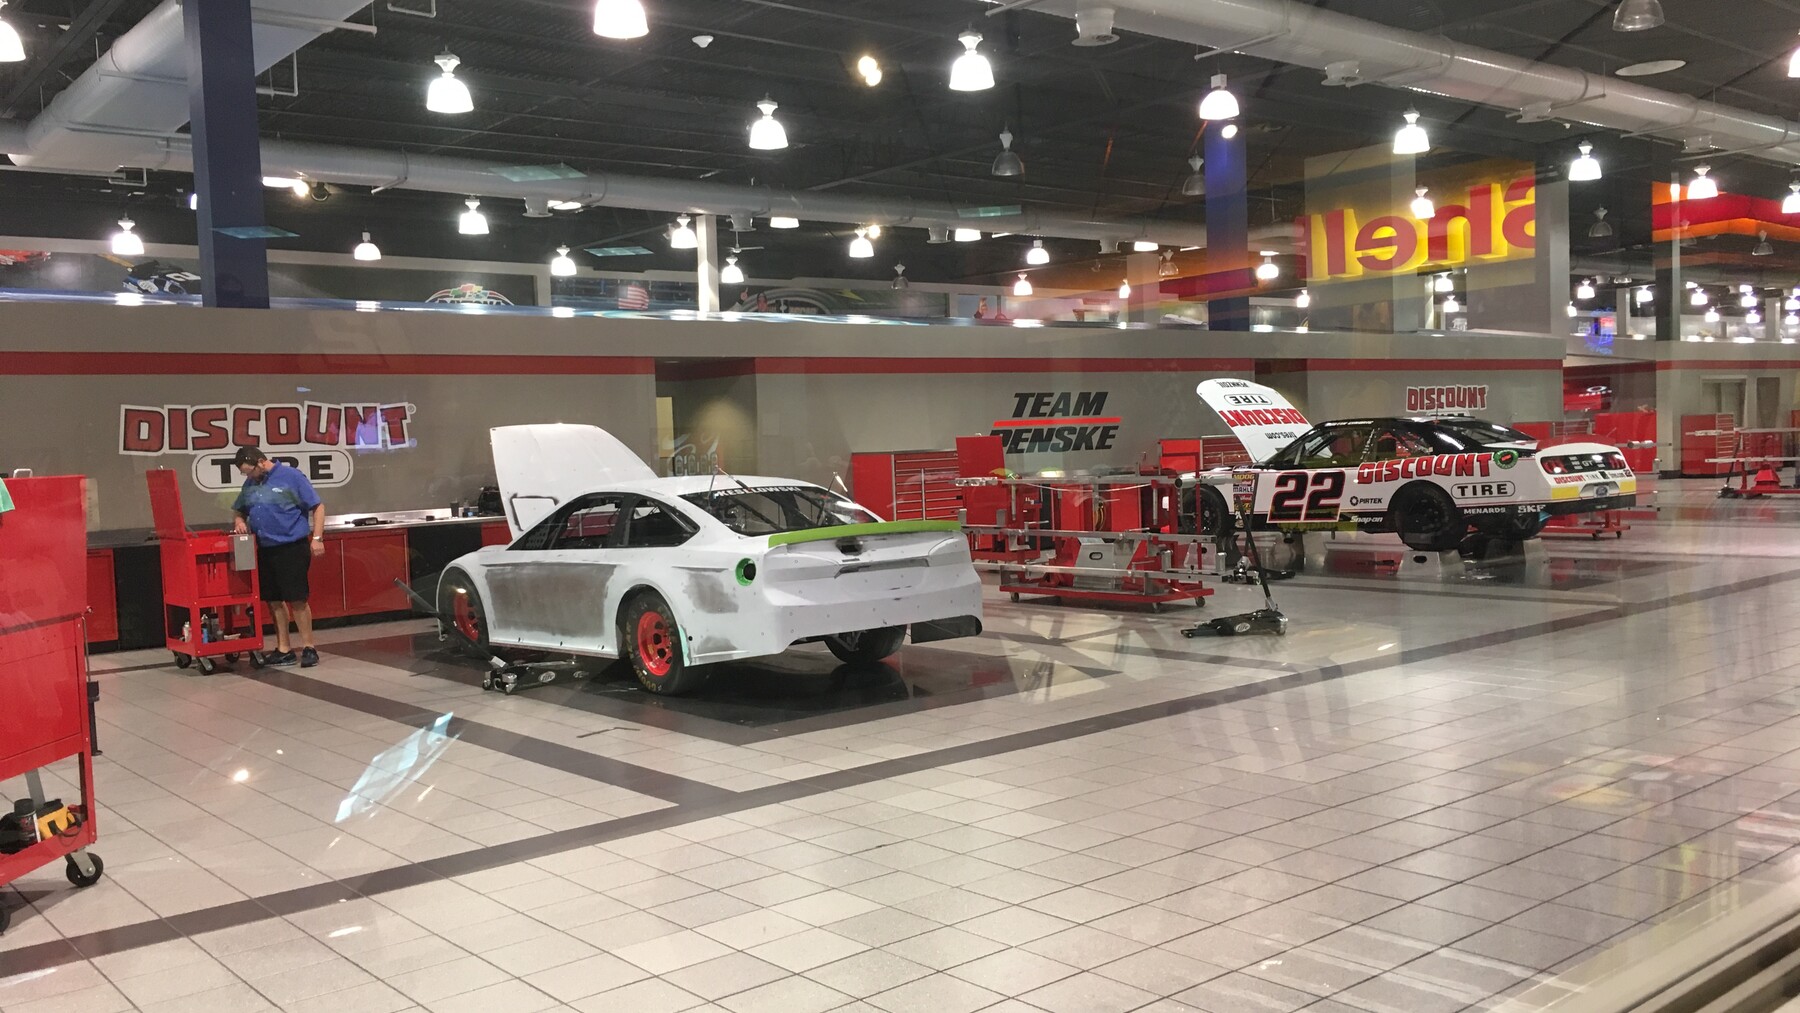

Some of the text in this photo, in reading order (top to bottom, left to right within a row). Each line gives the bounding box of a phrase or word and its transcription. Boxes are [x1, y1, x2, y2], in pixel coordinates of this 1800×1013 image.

[1012, 391, 1109, 418] TEAM
[1229, 395, 1269, 405] TIRE
[1406, 386, 1486, 411] DISCOUNT
[121, 402, 409, 453] DISCOUNT
[1218, 408, 1308, 427] DISCOUNT
[989, 425, 1120, 454] PENSKE
[211, 455, 334, 484] TE
[1357, 453, 1493, 484] DISCOUNT
[1267, 470, 1346, 523] 22
[1358, 497, 1383, 505] PIRTEK
[1457, 483, 1508, 497] TIRE
[1350, 515, 1384, 525] Snap-on
[1463, 507, 1506, 515] MENARDS
[1517, 504, 1546, 514] SKF
